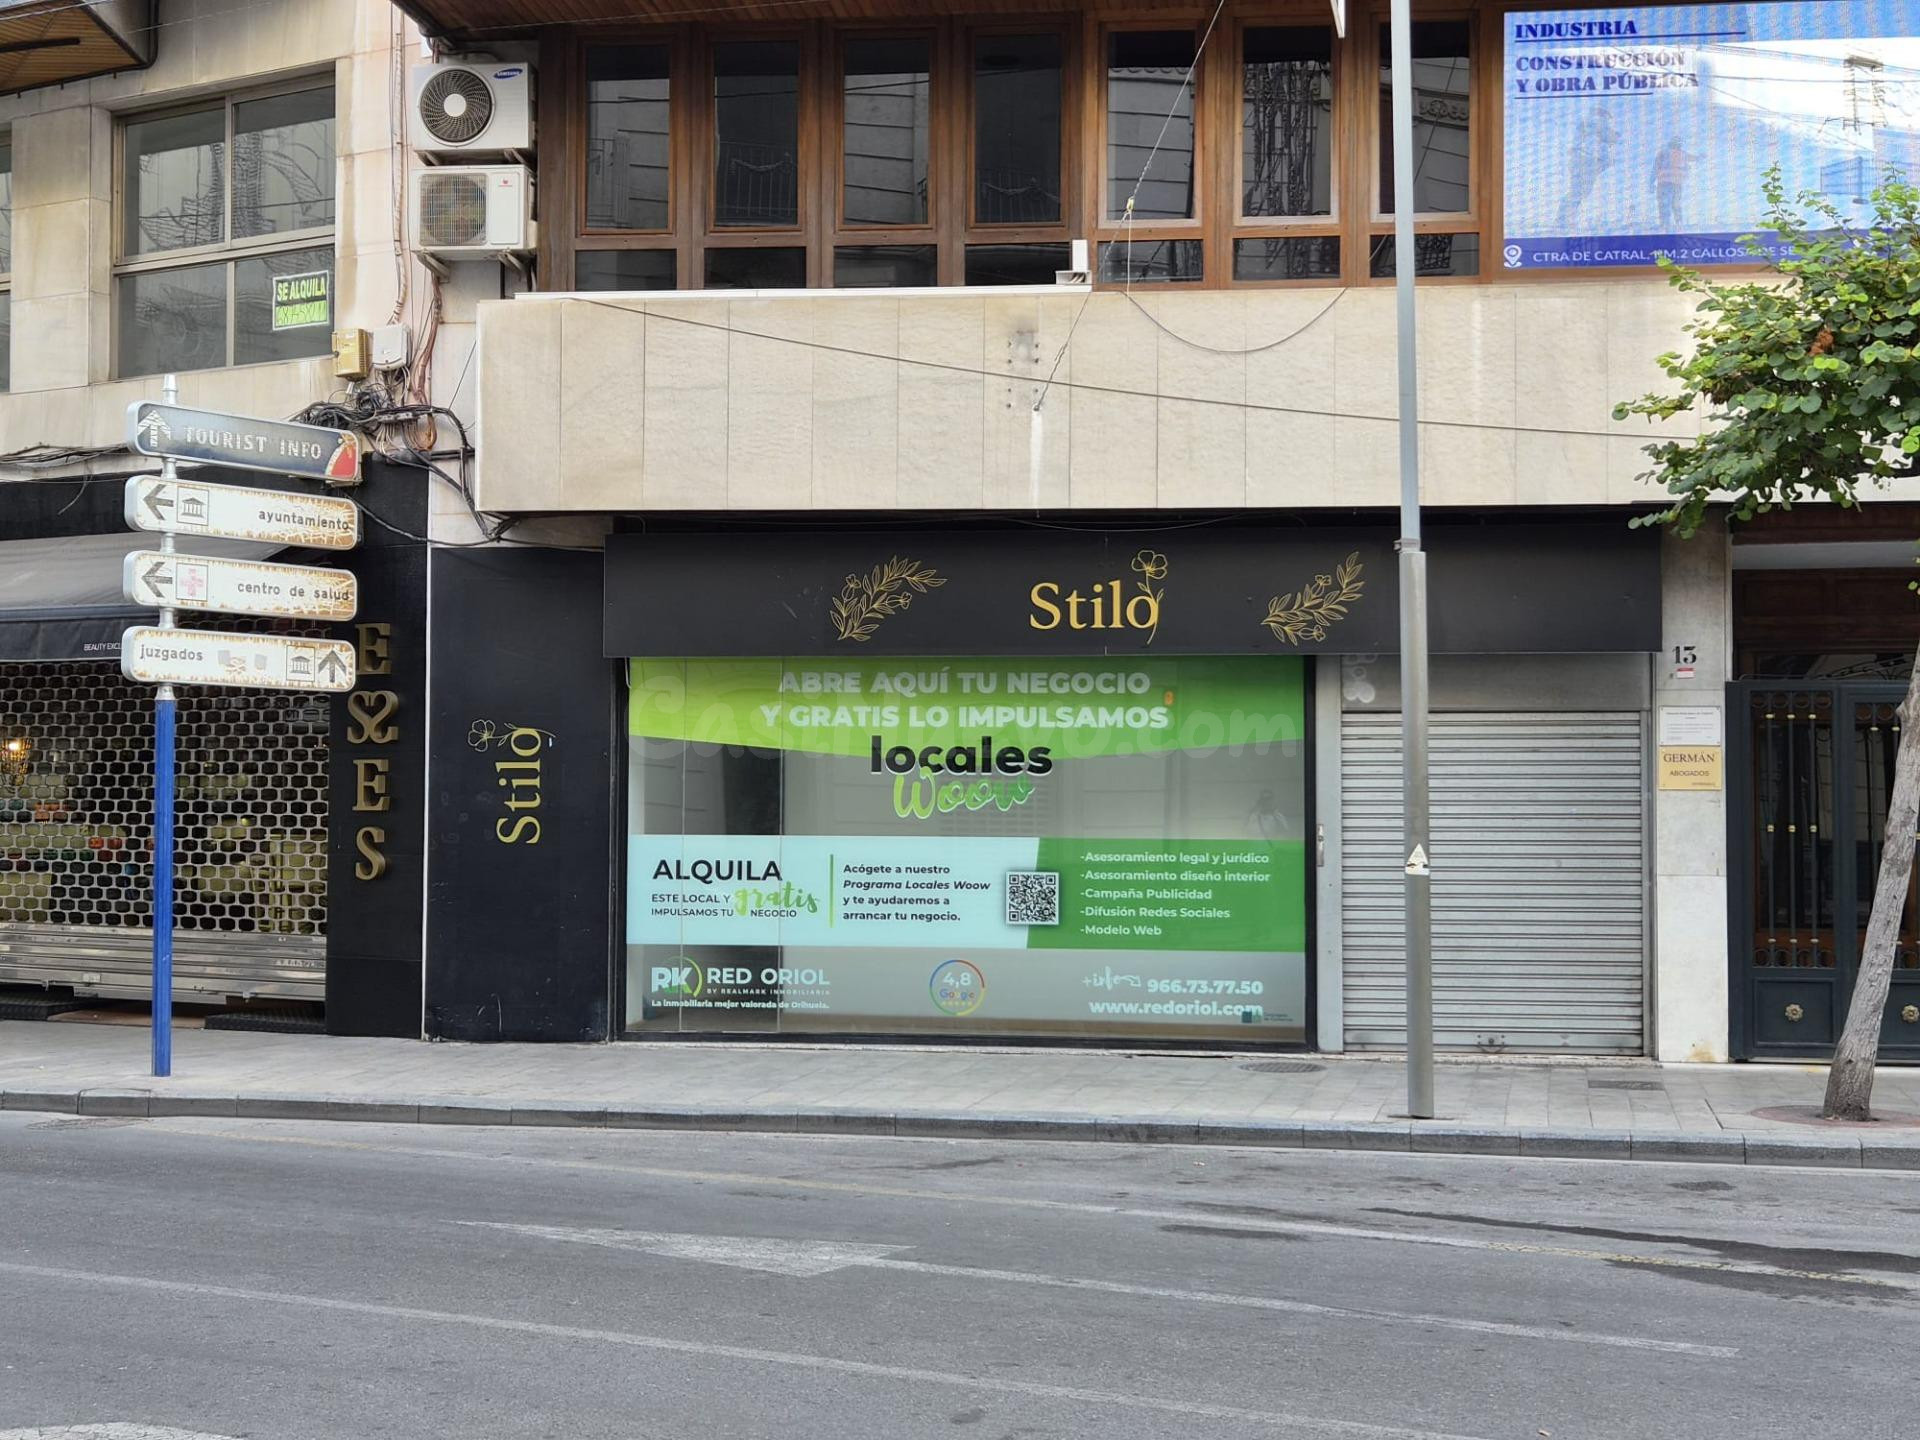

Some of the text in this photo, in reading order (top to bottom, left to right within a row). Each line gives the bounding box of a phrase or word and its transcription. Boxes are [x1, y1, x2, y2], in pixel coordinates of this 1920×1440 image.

[1515, 20, 1637, 38] INDUSTRIA
[1516, 48, 1685, 72] CONSTRUCCIÓN
[1516, 72, 1699, 93] Y OBRA PÚBLICA
[1533, 251, 1570, 262] CTRA
[1573, 251, 1591, 261] DE
[277, 276, 326, 302] SE ALQUILA
[184, 427, 322, 459] TOURIST INFO
[258, 508, 349, 531] ayuntamiento
[237, 581, 350, 601] centro de salud
[1030, 579, 1159, 630] Stilo
[83, 643, 106, 651] BEAUTY
[140, 643, 204, 662] juzgados
[1672, 645, 1697, 664] 13
[779, 666, 1151, 697] ABRE AQUÍ TU NEGOCIO
[760, 705, 1169, 729] Y GRATIS LO IMPULSAMOS
[871, 735, 1053, 776] locales
[1663, 751, 1715, 763] GERMÁN
[495, 727, 541, 844] Stilo
[1180, 852, 1209, 865] legal
[1212, 855, 1221, 865] y
[1221, 852, 1270, 866] jurídico
[652, 859, 783, 885] ALQUILA
[843, 864, 892, 875] Acógete
[905, 865, 951, 874] nuestro
[1180, 870, 1222, 882] diseño
[1224, 870, 1271, 882] interior
[843, 879, 991, 891] Programa Locales Woow
[651, 881, 821, 917] ESTE LOCAL Y gratis
[843, 897, 850, 905] y
[853, 896, 865, 904] te
[868, 895, 940, 906] ayudaremos
[1146, 888, 1213, 900] Publicidad
[651, 908, 798, 918] IMPULSAMOS TU NEGOCIO
[843, 911, 961, 922] arrancar tu negocio.
[1139, 906, 1177, 918] Redes
[1180, 907, 1231, 918] Sociales
[1133, 925, 1162, 936] Web
[706, 967, 752, 985] RED
[760, 967, 831, 986] ORIOL
[943, 972, 971, 988] 4,8
[721, 988, 767, 996] REALMARK
[1147, 979, 1264, 995] 966.73.77.50
[663, 999, 713, 1007] inmobiliaria
[714, 1000, 739, 1009] mejor
[740, 1000, 777, 1008] valorada
[778, 1000, 790, 1008] de
[1089, 1000, 1264, 1017] www.redoriol.com
